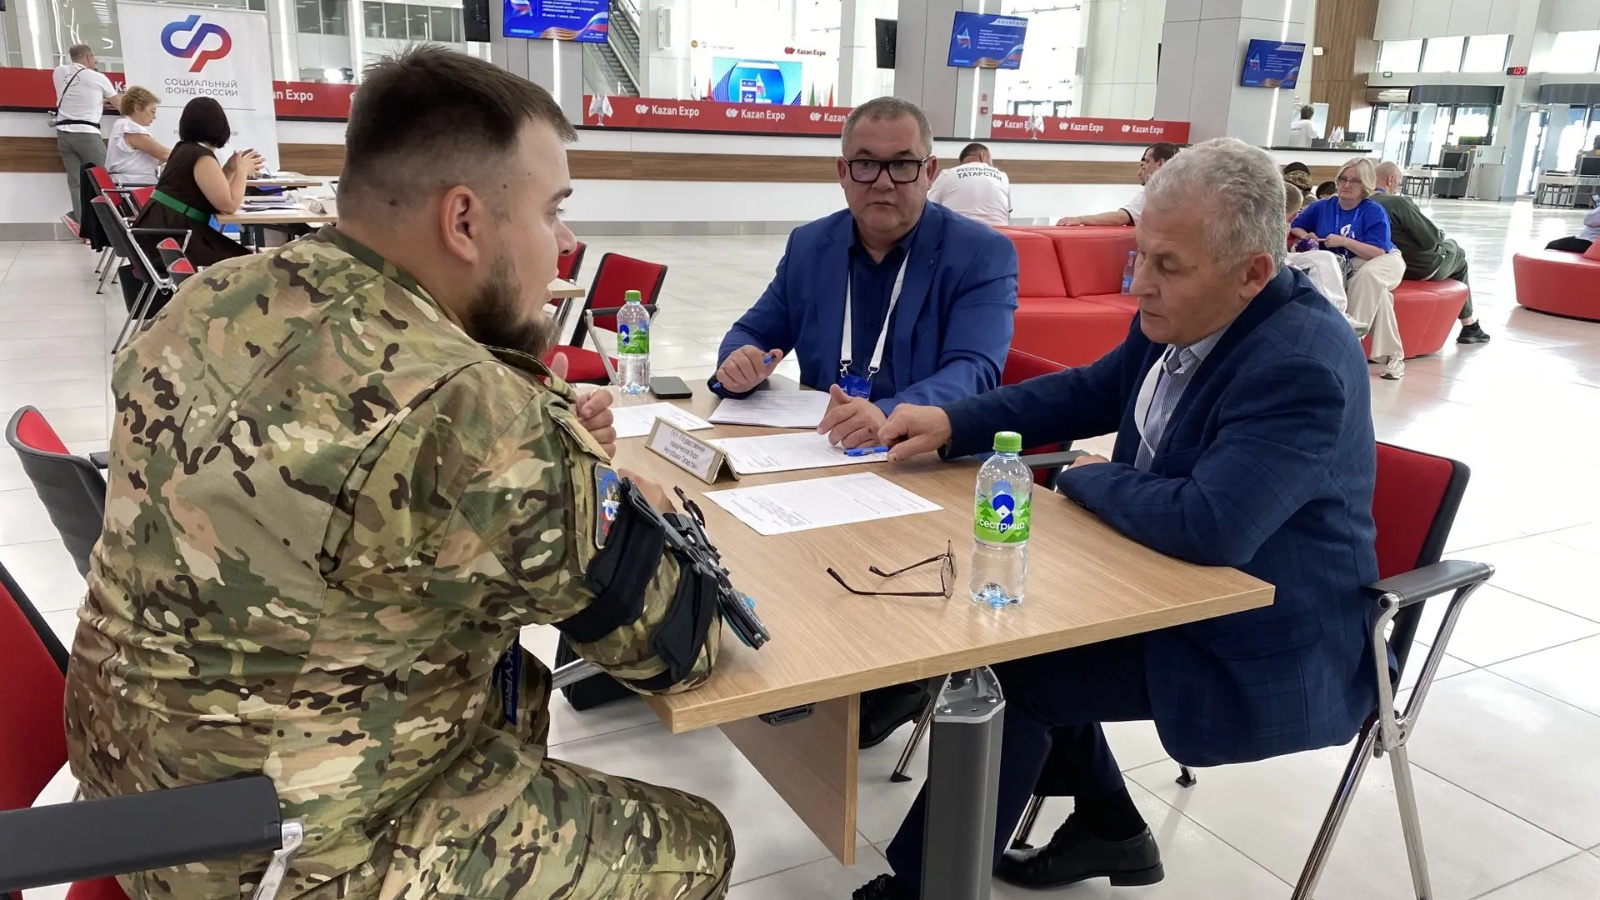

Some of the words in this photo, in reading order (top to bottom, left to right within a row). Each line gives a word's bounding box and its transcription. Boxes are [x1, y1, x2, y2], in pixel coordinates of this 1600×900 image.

[813, 49, 826, 57] Expo
[164, 78, 238, 88] СОЦИАЛЬНЫЙ
[199, 89, 238, 97] РОССИИ
[285, 89, 314, 103] Expo
[652, 105, 678, 115] Kazan
[679, 106, 700, 118] Expo
[741, 109, 765, 119] Kazan
[766, 110, 786, 122] Expo
[824, 112, 846, 122] Kazan
[1004, 119, 1023, 129] Kazan
[1070, 122, 1088, 131] Kazan
[1089, 123, 1104, 132] Expo
[1132, 125, 1149, 133] Kazan
[1149, 125, 1164, 135] Expo
[957, 171, 1002, 182] ТАТАРСТАН
[979, 518, 1025, 531] сестрица
